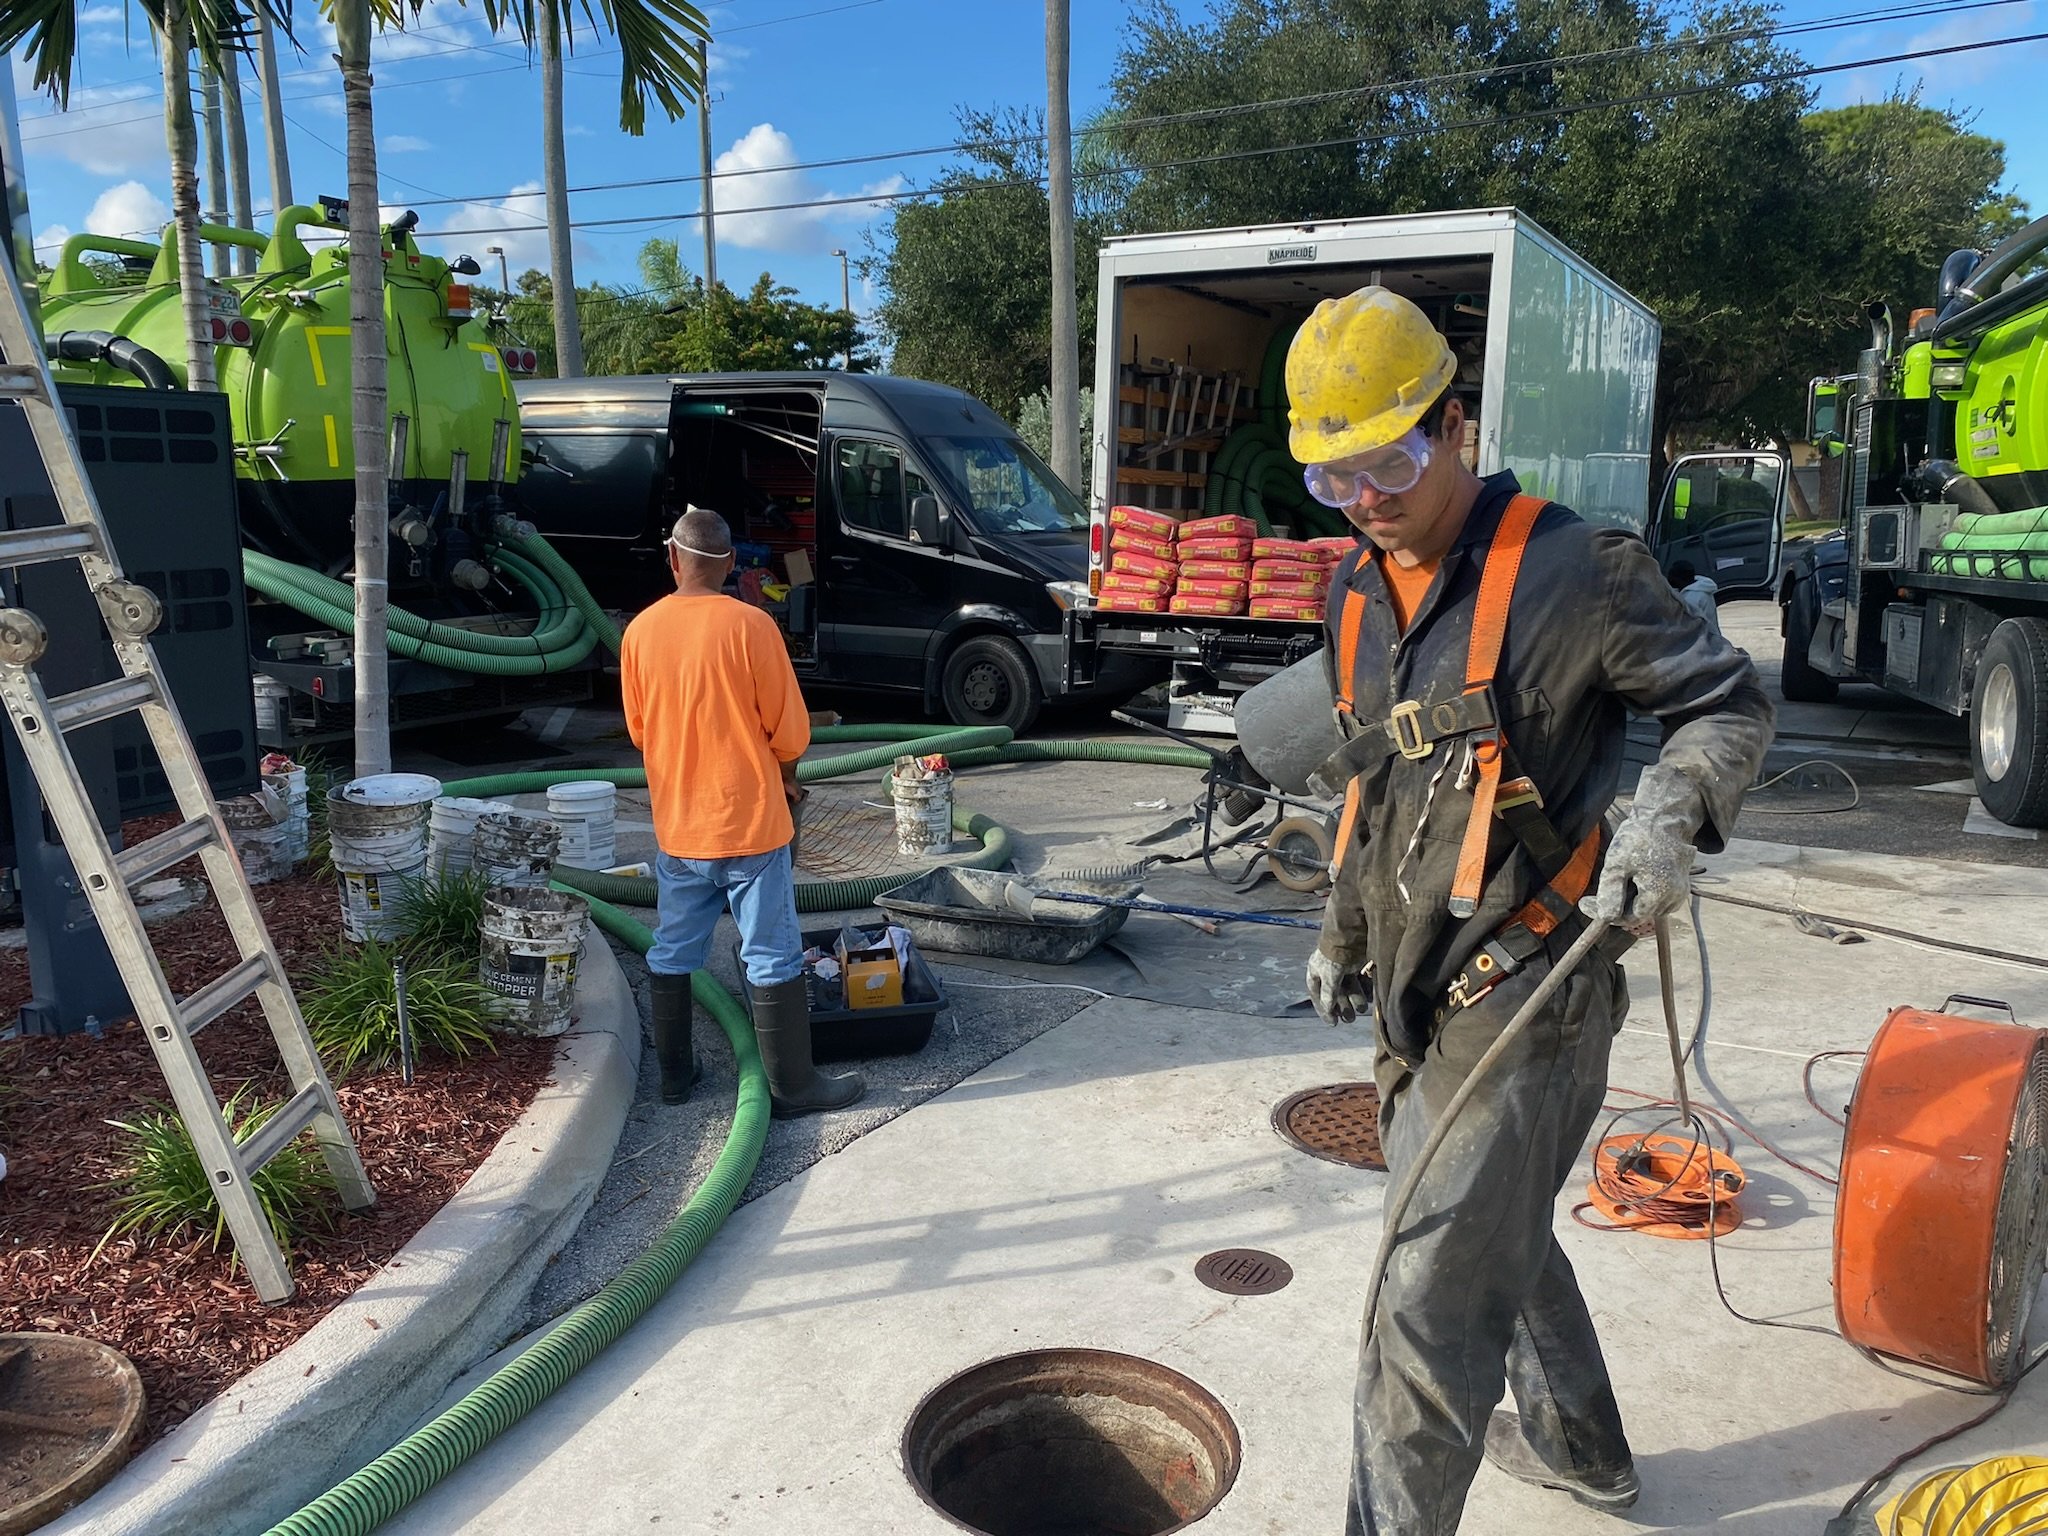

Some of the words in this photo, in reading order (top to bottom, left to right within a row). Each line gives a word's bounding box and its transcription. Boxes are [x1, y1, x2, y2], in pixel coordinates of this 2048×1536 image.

[1269, 246, 1313, 261] KNAPHEIDE
[500, 973, 537, 985] CEMENT
[486, 978, 537, 997] STOPPER
